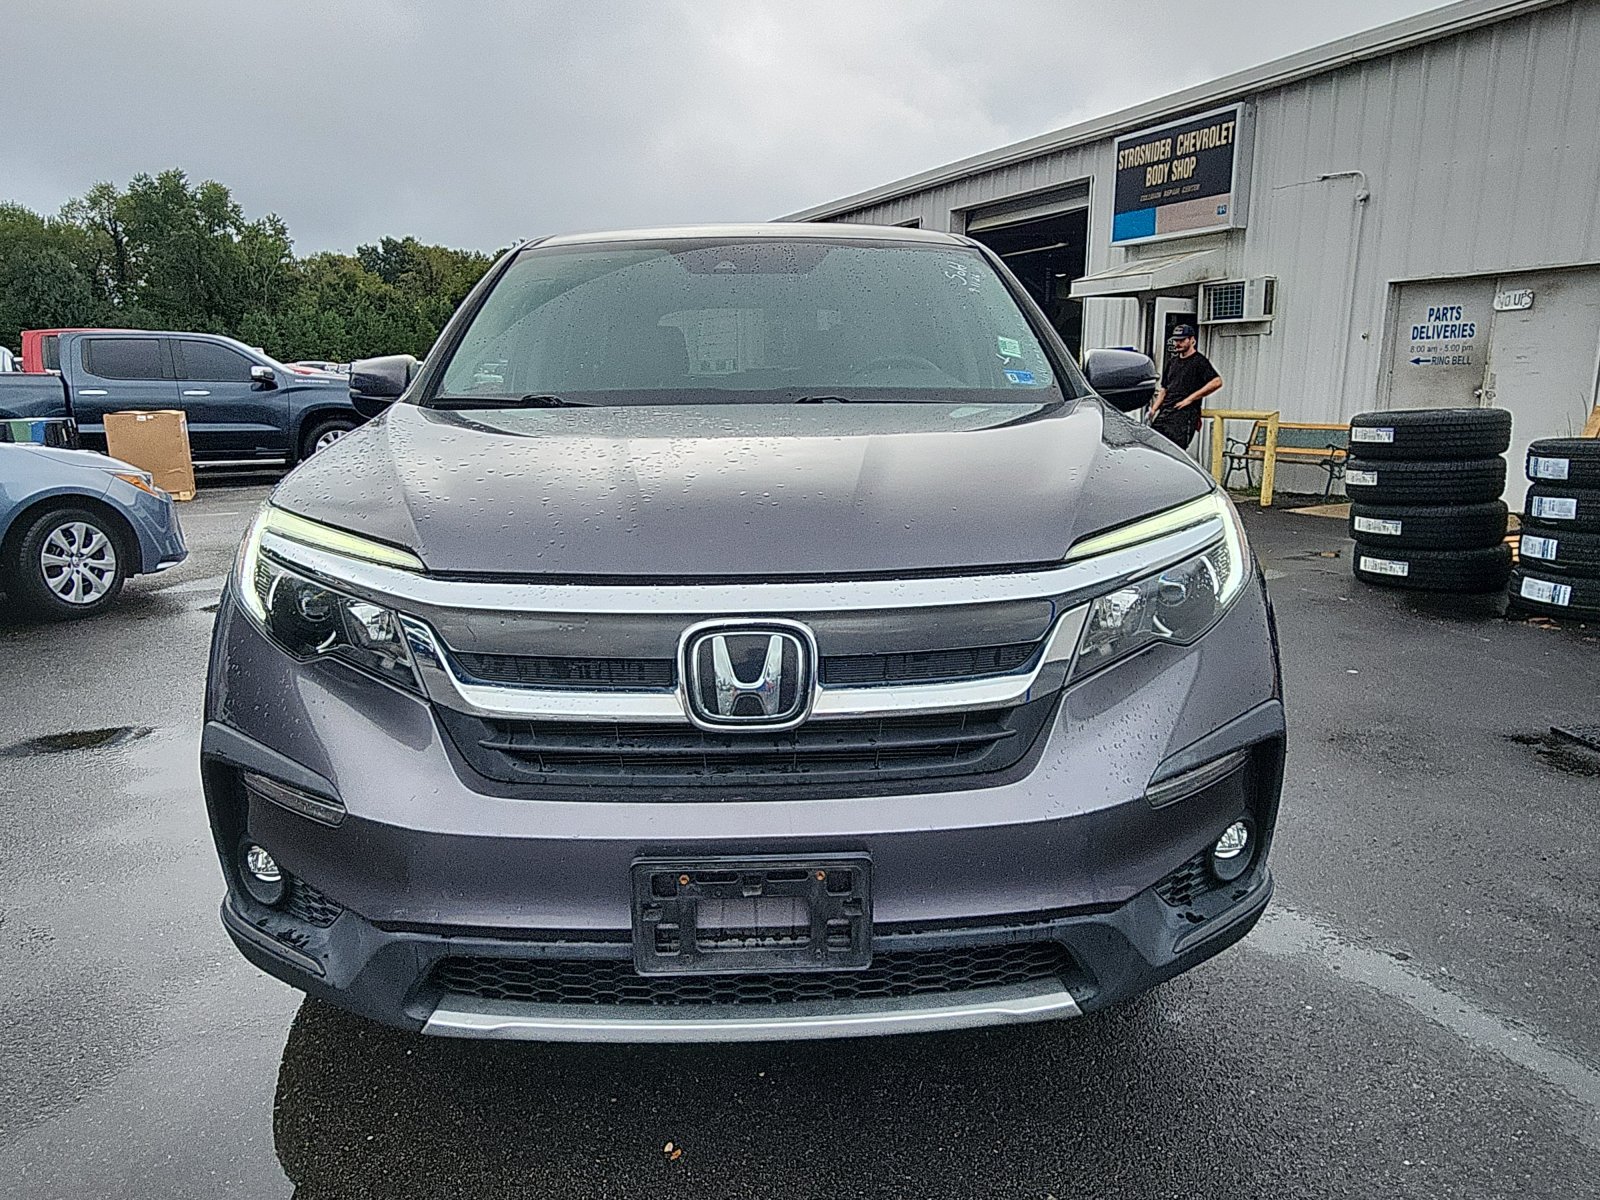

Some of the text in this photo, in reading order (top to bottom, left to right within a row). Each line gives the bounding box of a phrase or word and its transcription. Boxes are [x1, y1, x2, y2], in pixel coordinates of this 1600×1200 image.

[1118, 121, 1235, 170] STROSNIDER CHEVROLET
[1145, 156, 1196, 187] BODY SHOP
[1513, 291, 1533, 306] UPS
[1427, 306, 1462, 322] PARTS
[1411, 323, 1475, 340] DELIVERIES
[1461, 345, 1474, 354] pm
[1431, 356, 1472, 365] RING BELL
